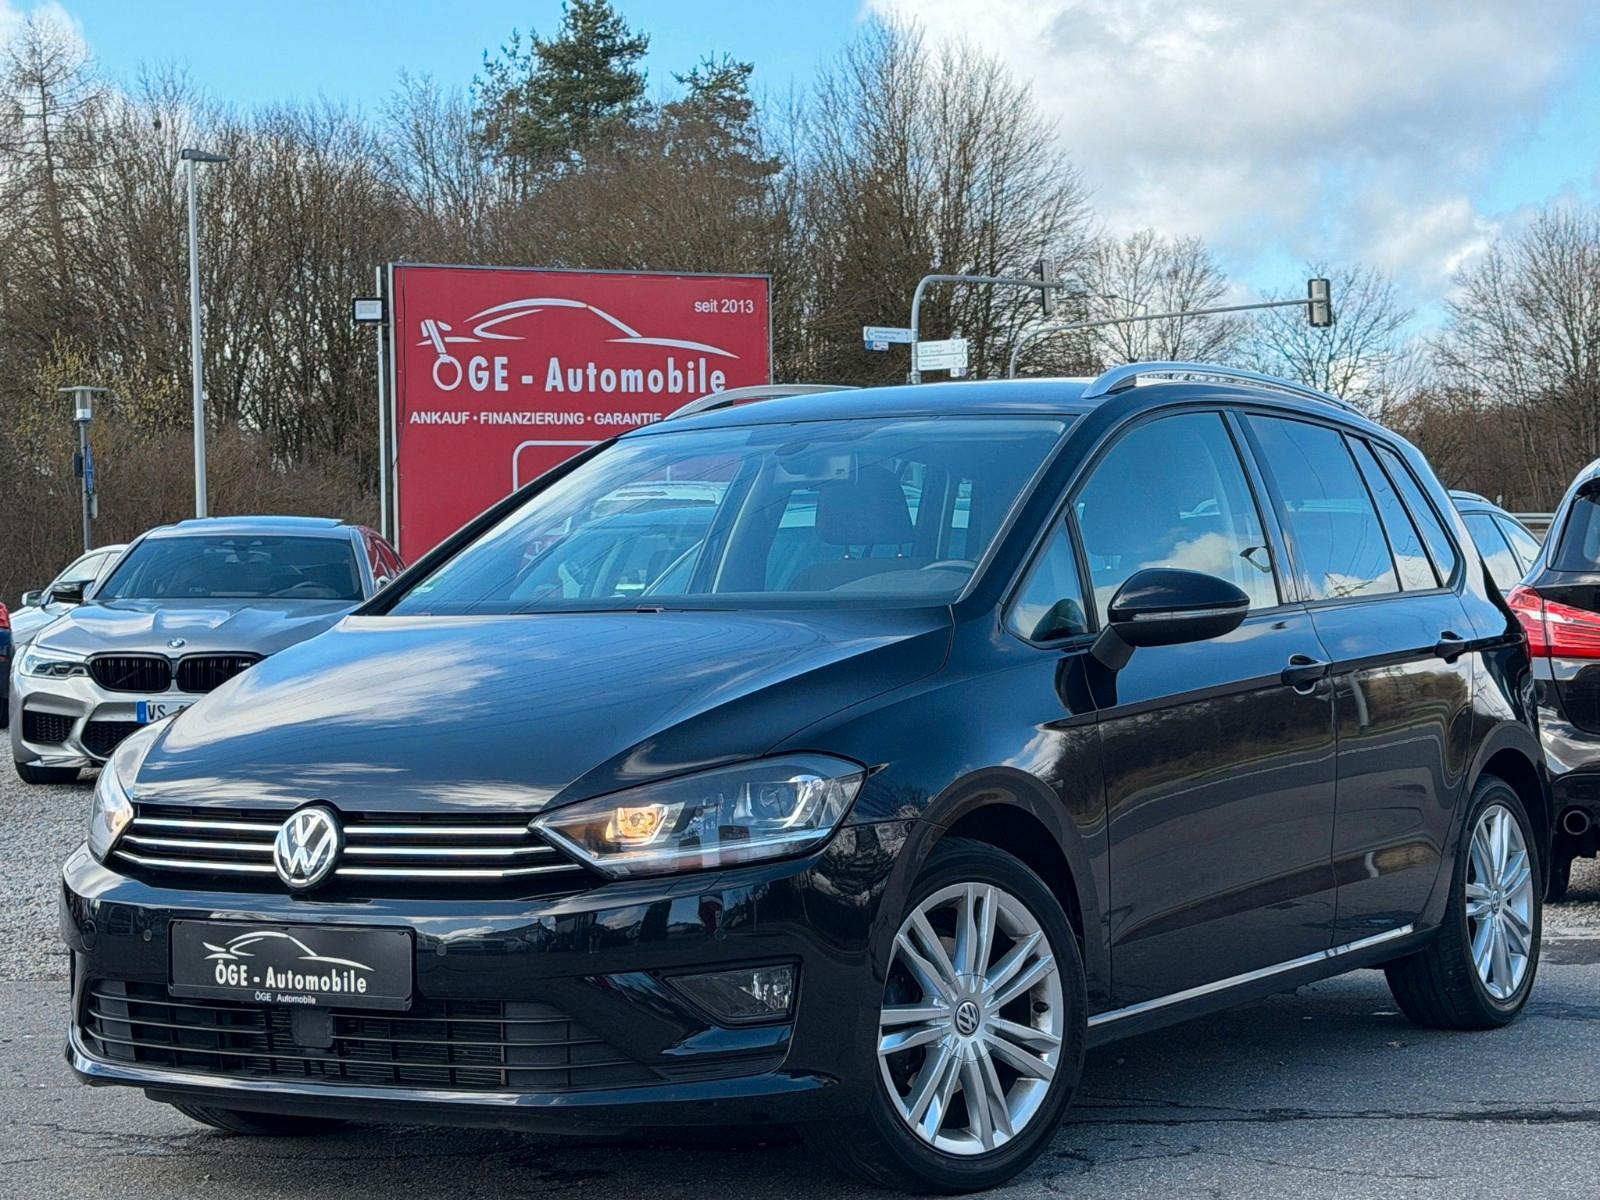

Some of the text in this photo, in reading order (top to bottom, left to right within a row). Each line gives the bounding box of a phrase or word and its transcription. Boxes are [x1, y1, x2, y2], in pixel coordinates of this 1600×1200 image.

[694, 299, 754, 313] seit 2013
[545, 357, 726, 394] Automobile
[410, 412, 470, 424] ANKAUF
[480, 412, 585, 425] FINANZIERUNG
[147, 704, 166, 720] VS
[265, 966, 367, 993] Automobile
[254, 991, 317, 1005] ÖGE Automobile
